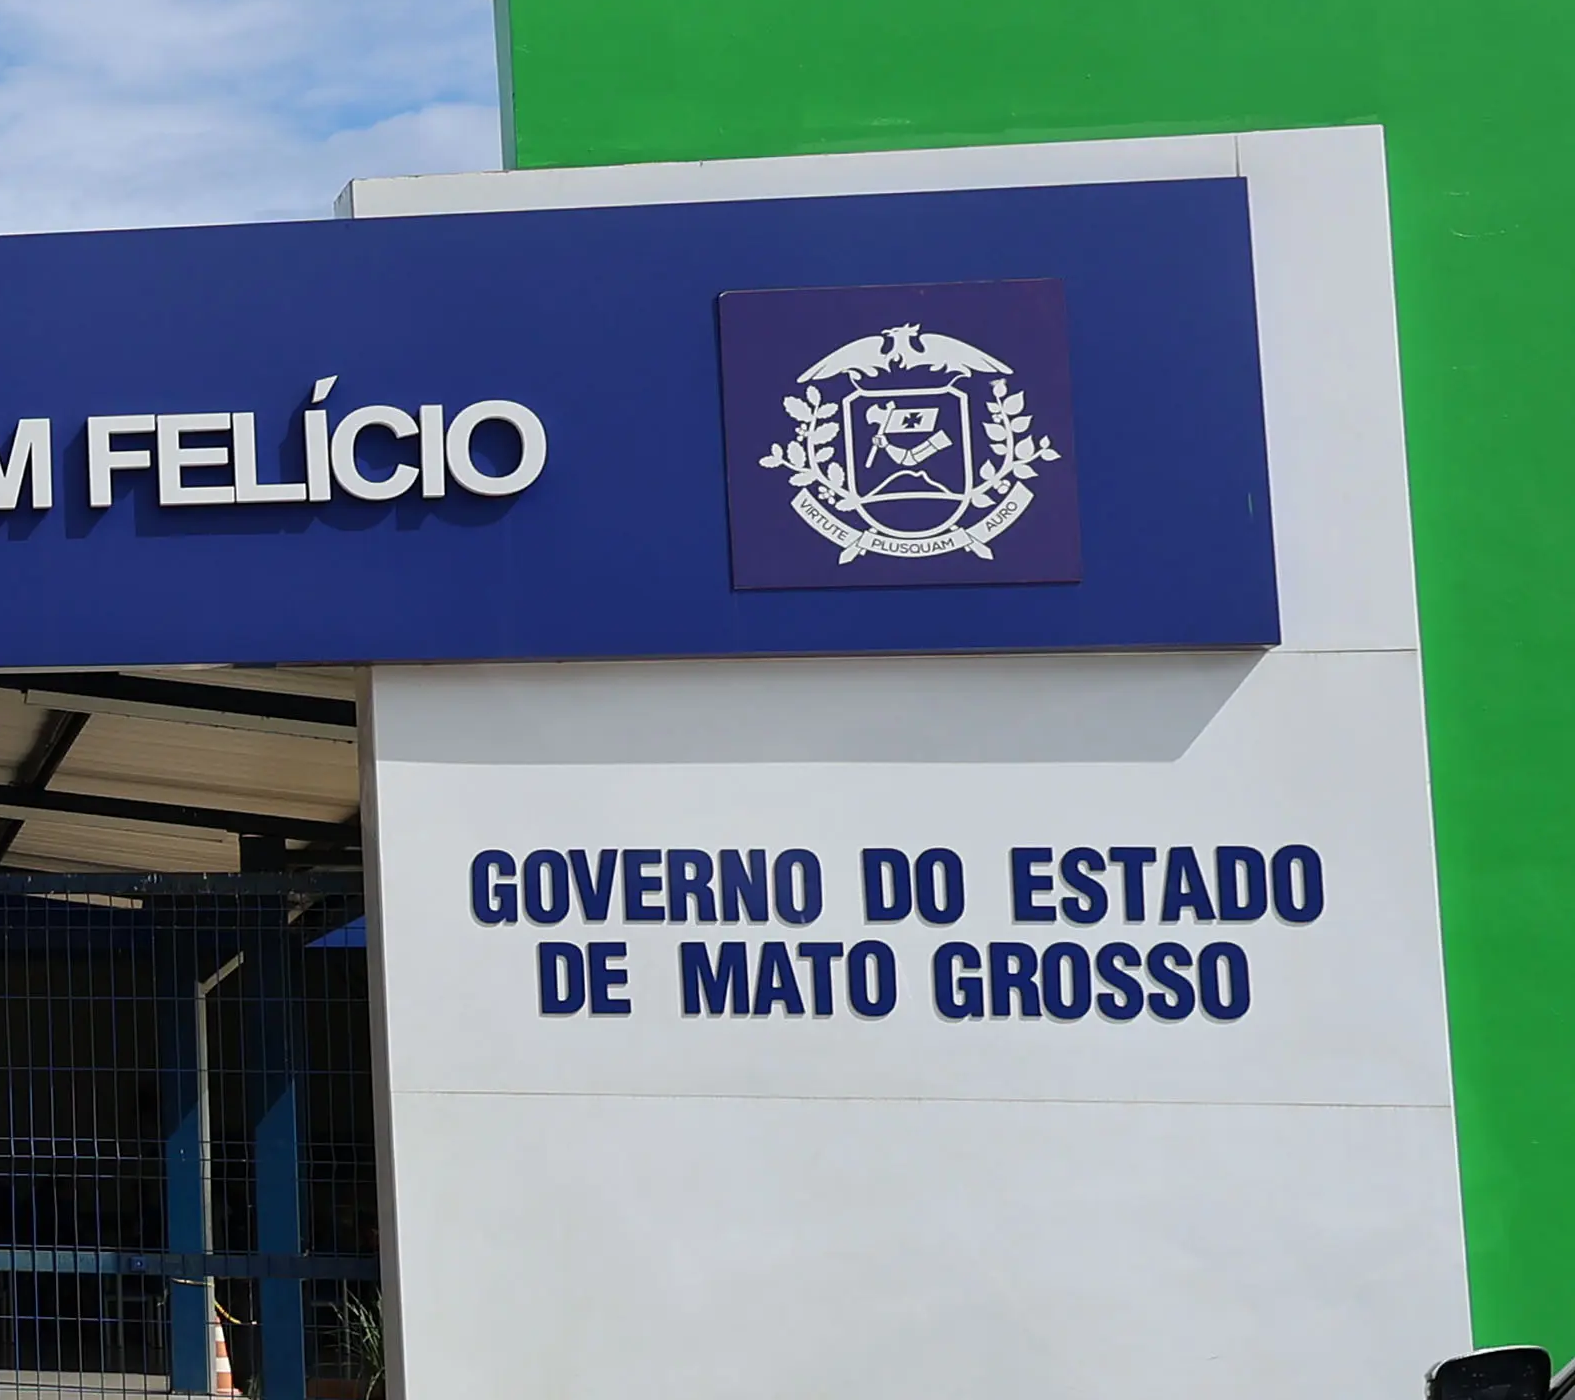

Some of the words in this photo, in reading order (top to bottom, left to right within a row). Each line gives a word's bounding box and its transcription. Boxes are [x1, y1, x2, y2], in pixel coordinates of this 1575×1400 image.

[87, 374, 549, 508] FELÍCIO
[800, 498, 849, 542] VIRTUTE
[871, 537, 956, 554] PLUSQUAM
[984, 501, 1018, 532] AURO
[472, 847, 824, 925] GOVERNO
[861, 847, 965, 925] DO
[1011, 843, 1326, 925] ESTADO
[538, 941, 631, 1017] DE
[681, 939, 898, 1018] MATO
[933, 941, 1252, 1022] GROSSO
